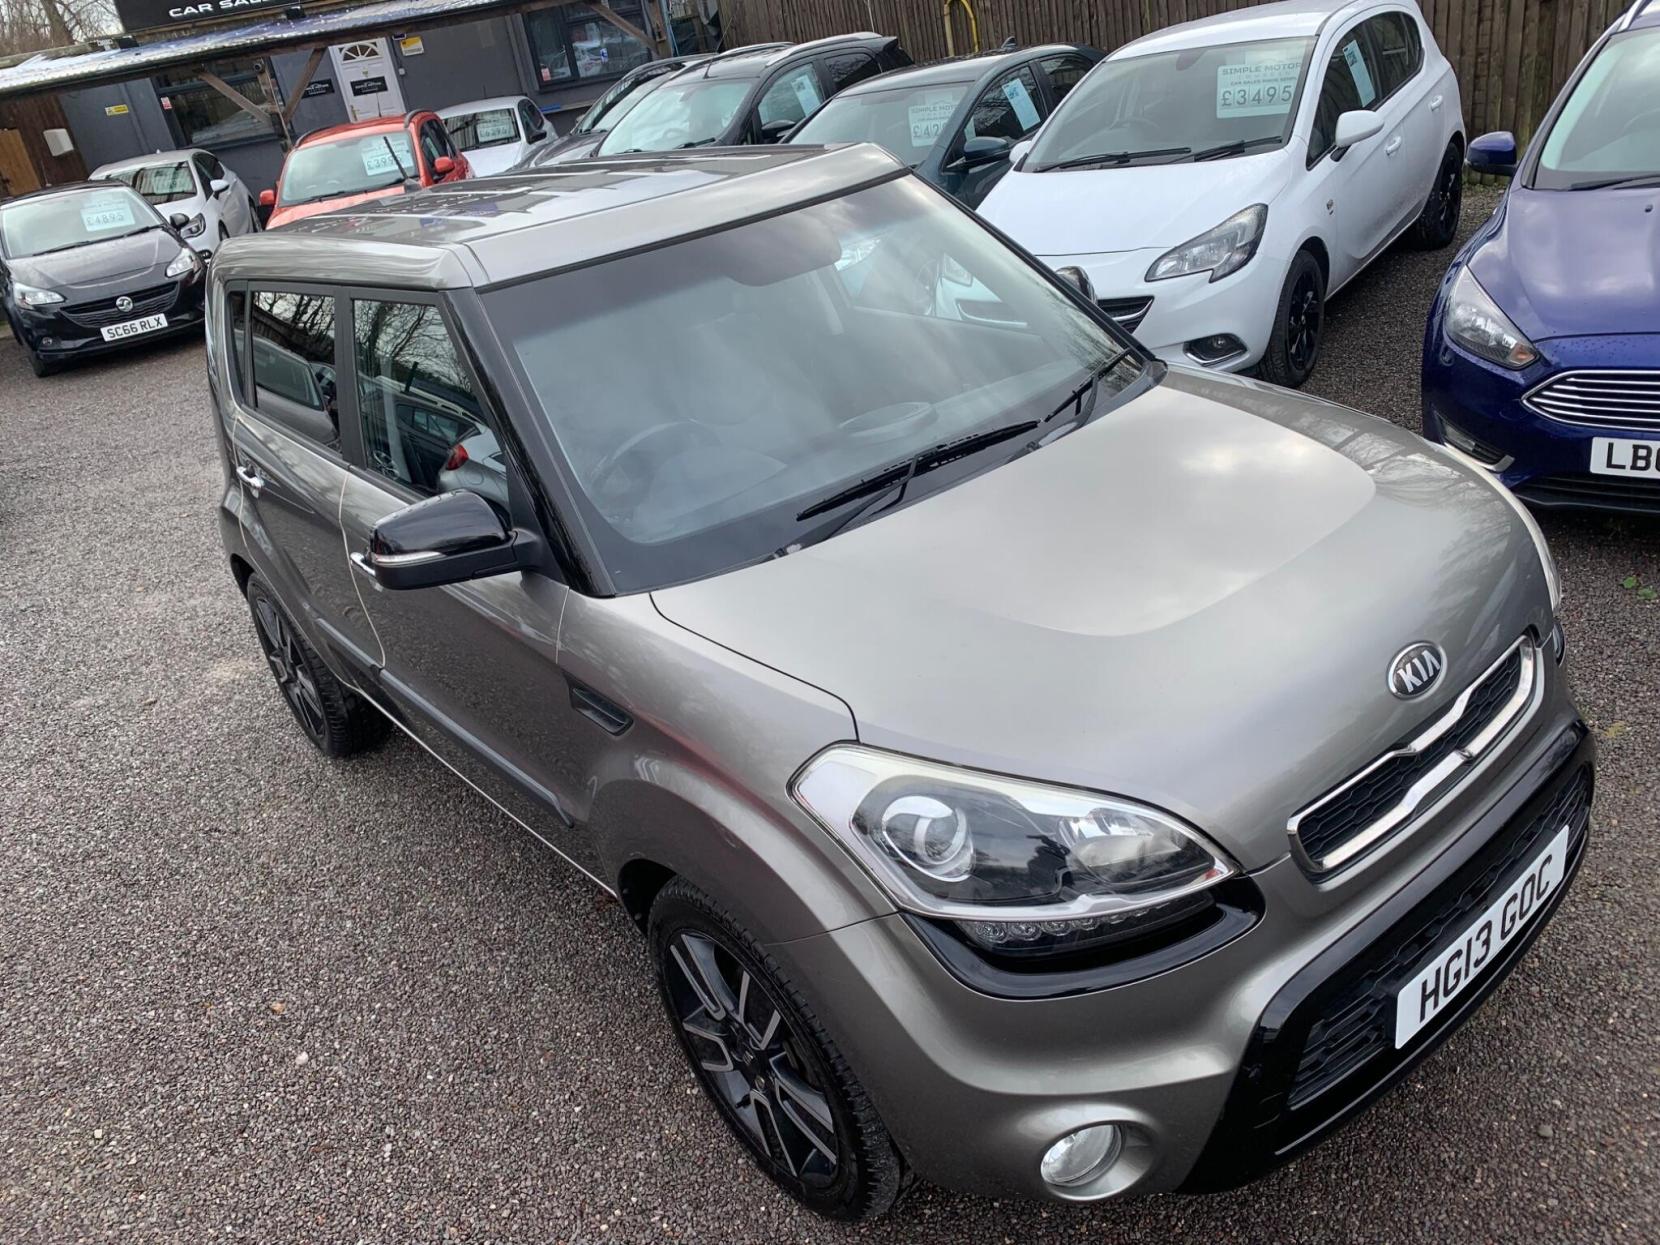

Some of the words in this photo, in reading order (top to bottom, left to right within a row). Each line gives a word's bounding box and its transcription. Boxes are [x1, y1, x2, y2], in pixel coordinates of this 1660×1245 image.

[168, 3, 213, 17] CAR
[1221, 85, 1292, 107] £3495
[107, 322, 138, 338] SC66
[139, 316, 163, 331] RLX
[1606, 442, 1660, 473] LB
[1397, 649, 1441, 693] KIA
[1419, 919, 1493, 1024] HG13
[1500, 853, 1553, 941] GOC
